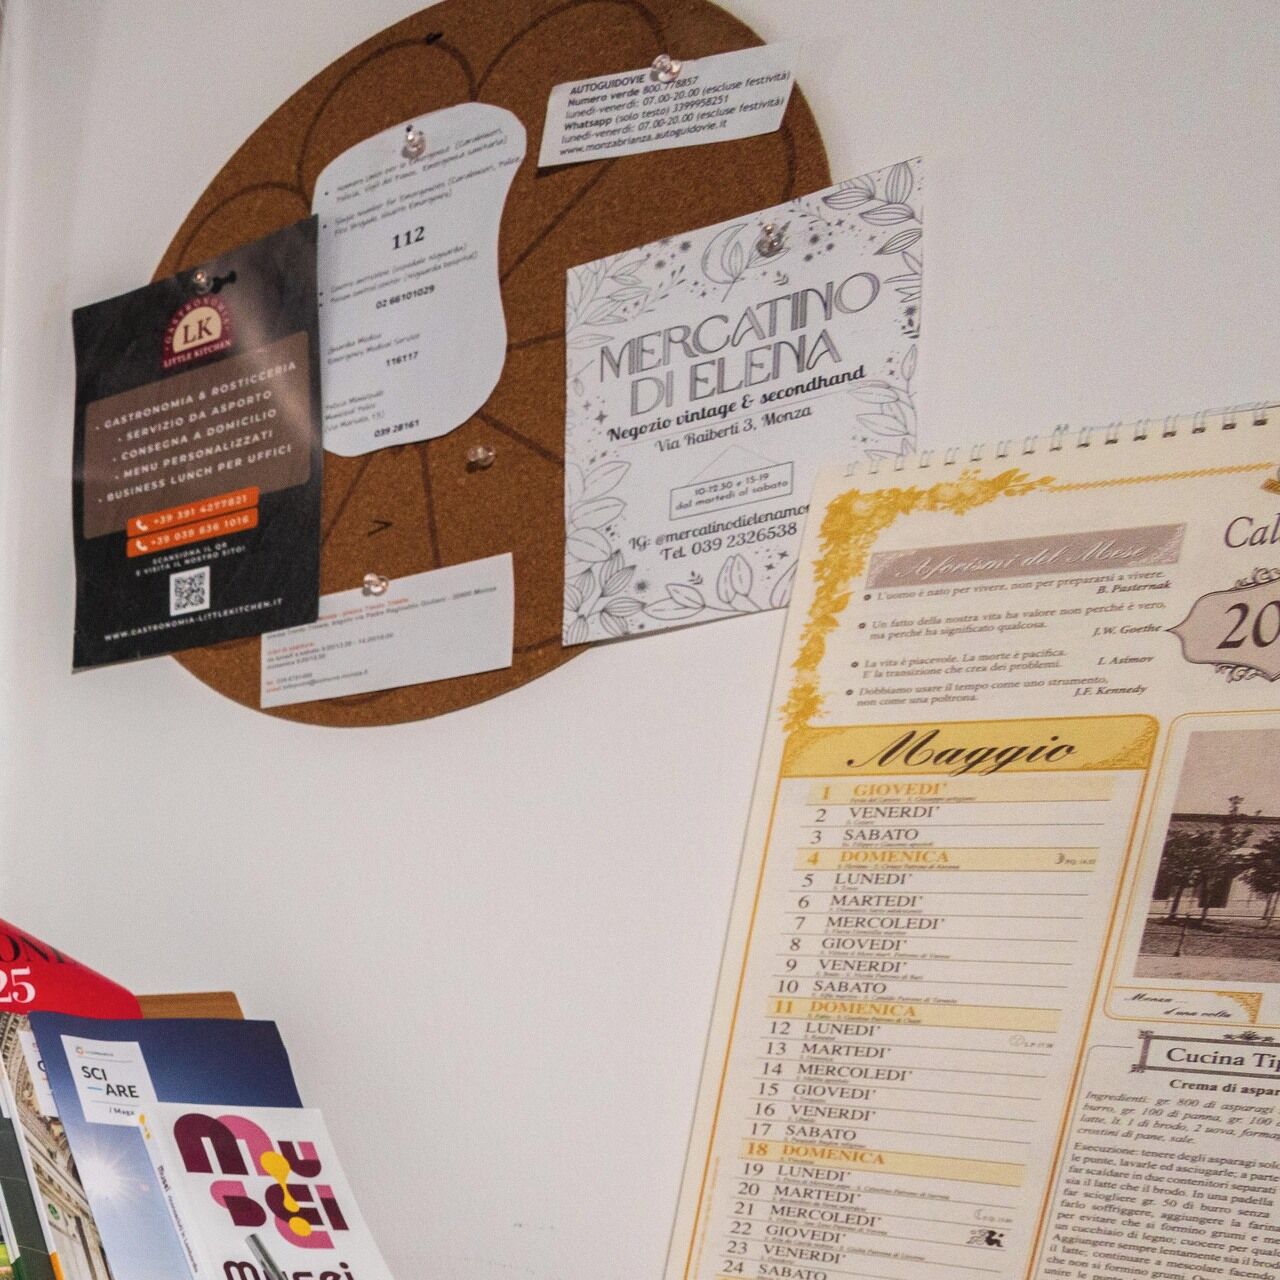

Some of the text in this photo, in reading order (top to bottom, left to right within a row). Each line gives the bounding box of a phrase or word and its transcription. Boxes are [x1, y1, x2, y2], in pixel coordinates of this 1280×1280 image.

[567, 94, 607, 107] Numero
[610, 88, 640, 99] verde
[569, 74, 647, 95] AUTOGUIDOVIE
[392, 226, 426, 250] 112
[182, 317, 214, 346] LK
[600, 272, 881, 383] MERCATINO
[164, 339, 232, 368] LITTLE KITCHEN
[630, 329, 842, 416] DI ELENA
[104, 394, 194, 430] GASTRONOMIA
[211, 361, 297, 397] ROSTICCERIA
[607, 365, 866, 443] Negozio vintage & secondhand
[126, 389, 272, 442] SERVIZIO DA ASPORTO
[655, 437, 680, 453] Via
[684, 422, 740, 447] Raiberti
[761, 405, 812, 427] Monza
[121, 408, 277, 461] CONSEGNA A DOMICILIO
[123, 429, 274, 480] MENU PERSONALIZZATI
[107, 444, 292, 503] BUSINESS LUNCH PER UFFICI
[692, 537, 722, 556] 039
[726, 522, 798, 548] 2326538
[847, 729, 1079, 777] Maggio
[822, 786, 831, 801] 1
[853, 783, 948, 797] GIOVEDI'
[815, 806, 941, 823] 2 VENERDI'
[811, 828, 919, 845] 3 SABATO
[807, 850, 949, 865] 4 DOMENICA
[1166, 1047, 1245, 1066] Cucina
[81, 1066, 107, 1081] SCI
[106, 1084, 139, 1098] ARE
